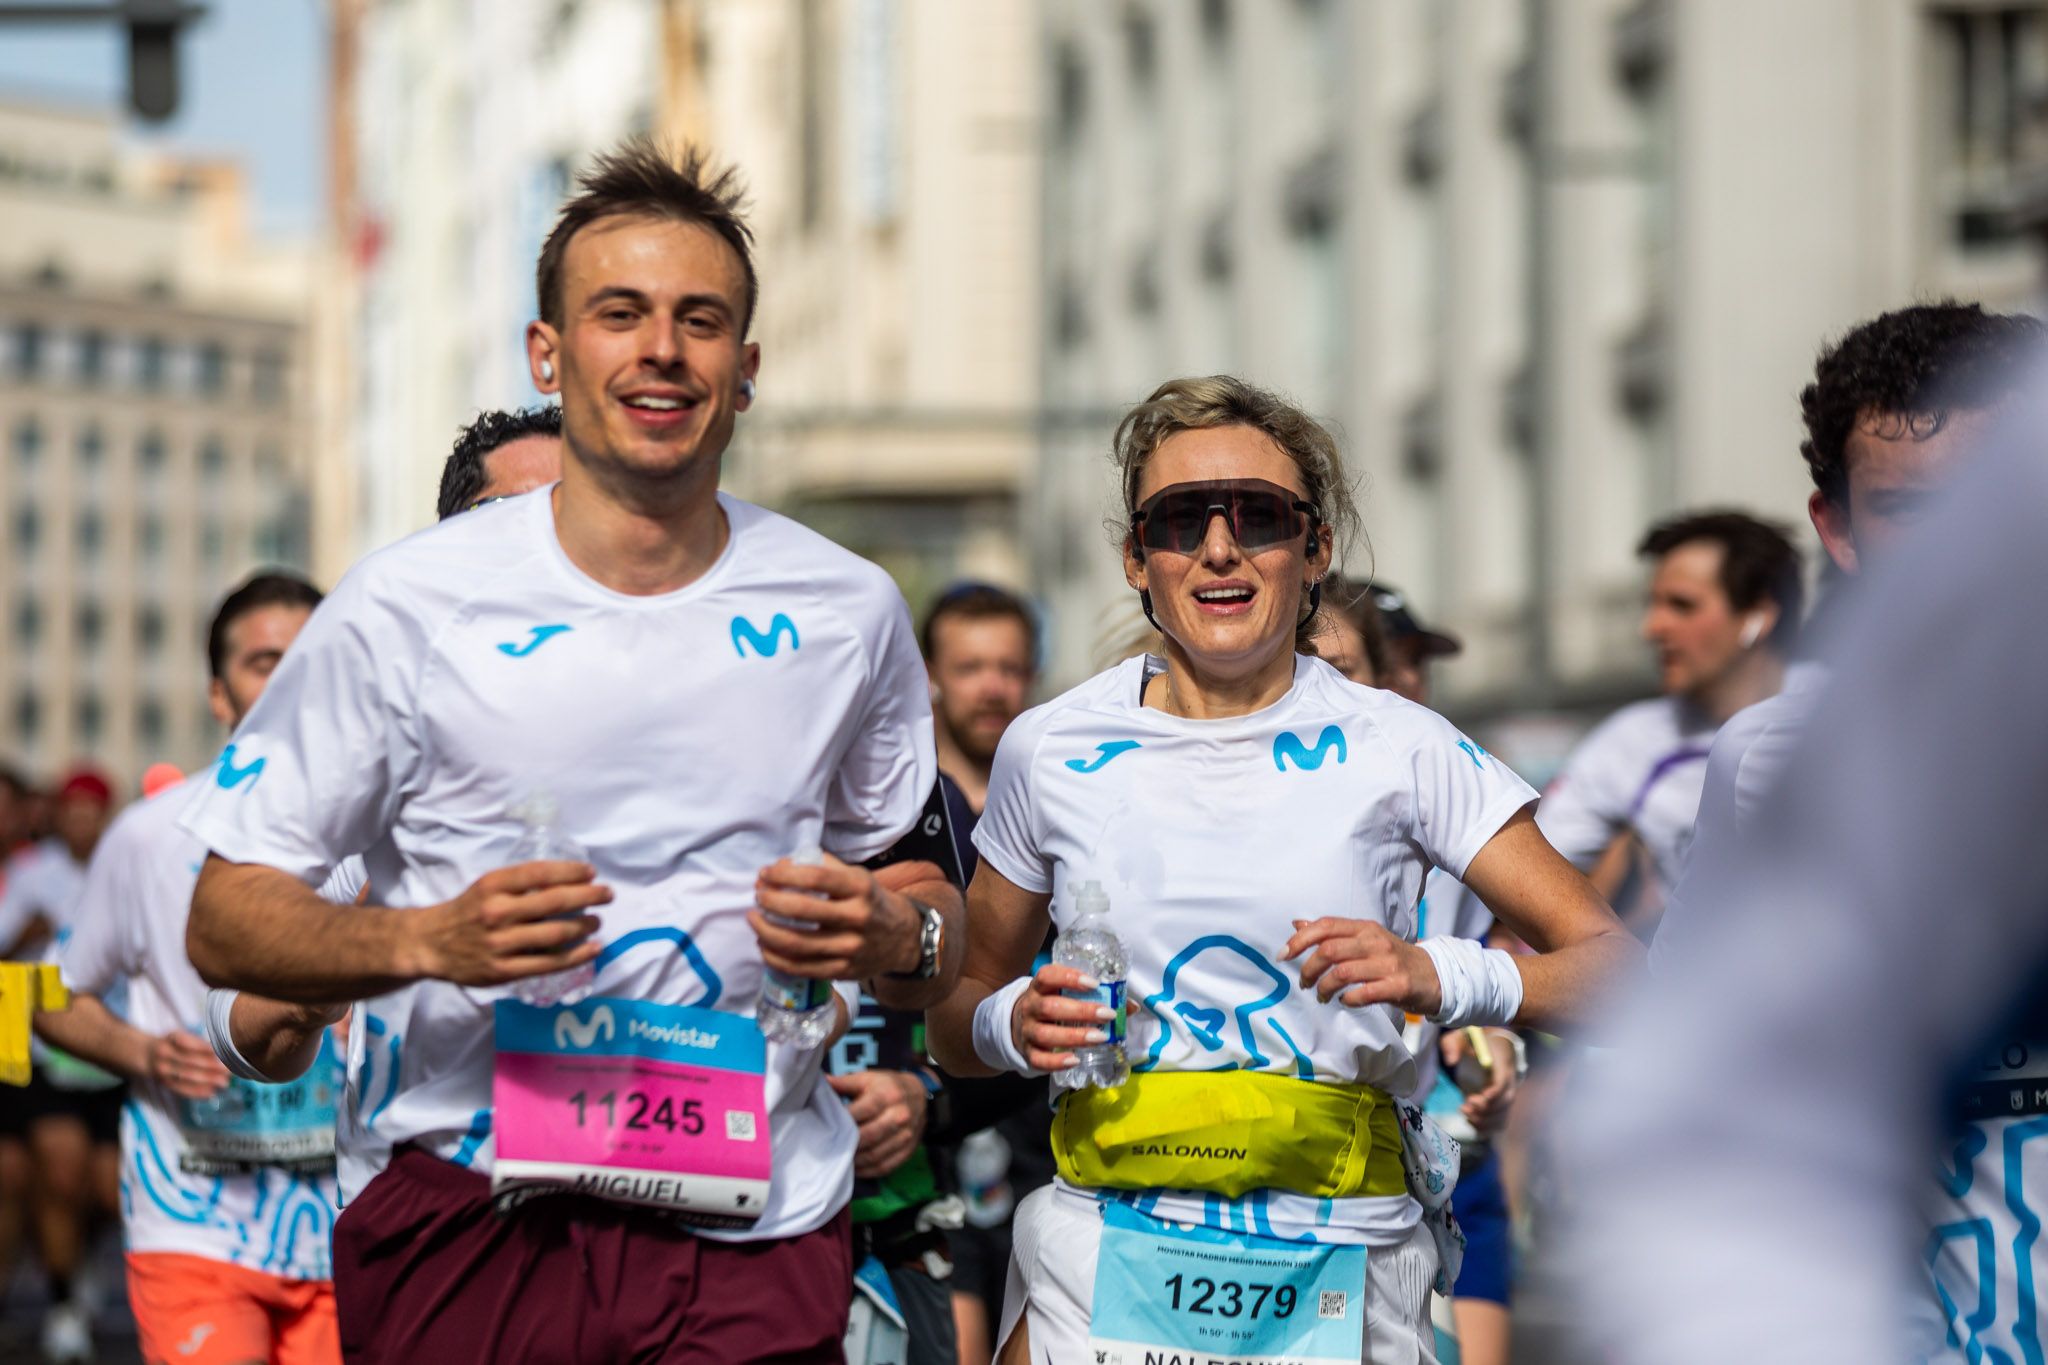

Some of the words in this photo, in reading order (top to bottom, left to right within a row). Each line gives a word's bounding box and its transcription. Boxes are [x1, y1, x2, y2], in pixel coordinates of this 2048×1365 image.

[628, 1018, 721, 1050] Movistar
[569, 1089, 705, 1135] 11245
[1131, 1144, 1247, 1160] SALOMON
[576, 1174, 690, 1204] MIGUEL
[1157, 1245, 1195, 1258] MOVISTAR
[1196, 1252, 1227, 1262] MADRID
[1228, 1256, 1254, 1265] MEDIO
[1255, 1259, 1293, 1268] MARATÓN
[1165, 1273, 1297, 1320] 12379
